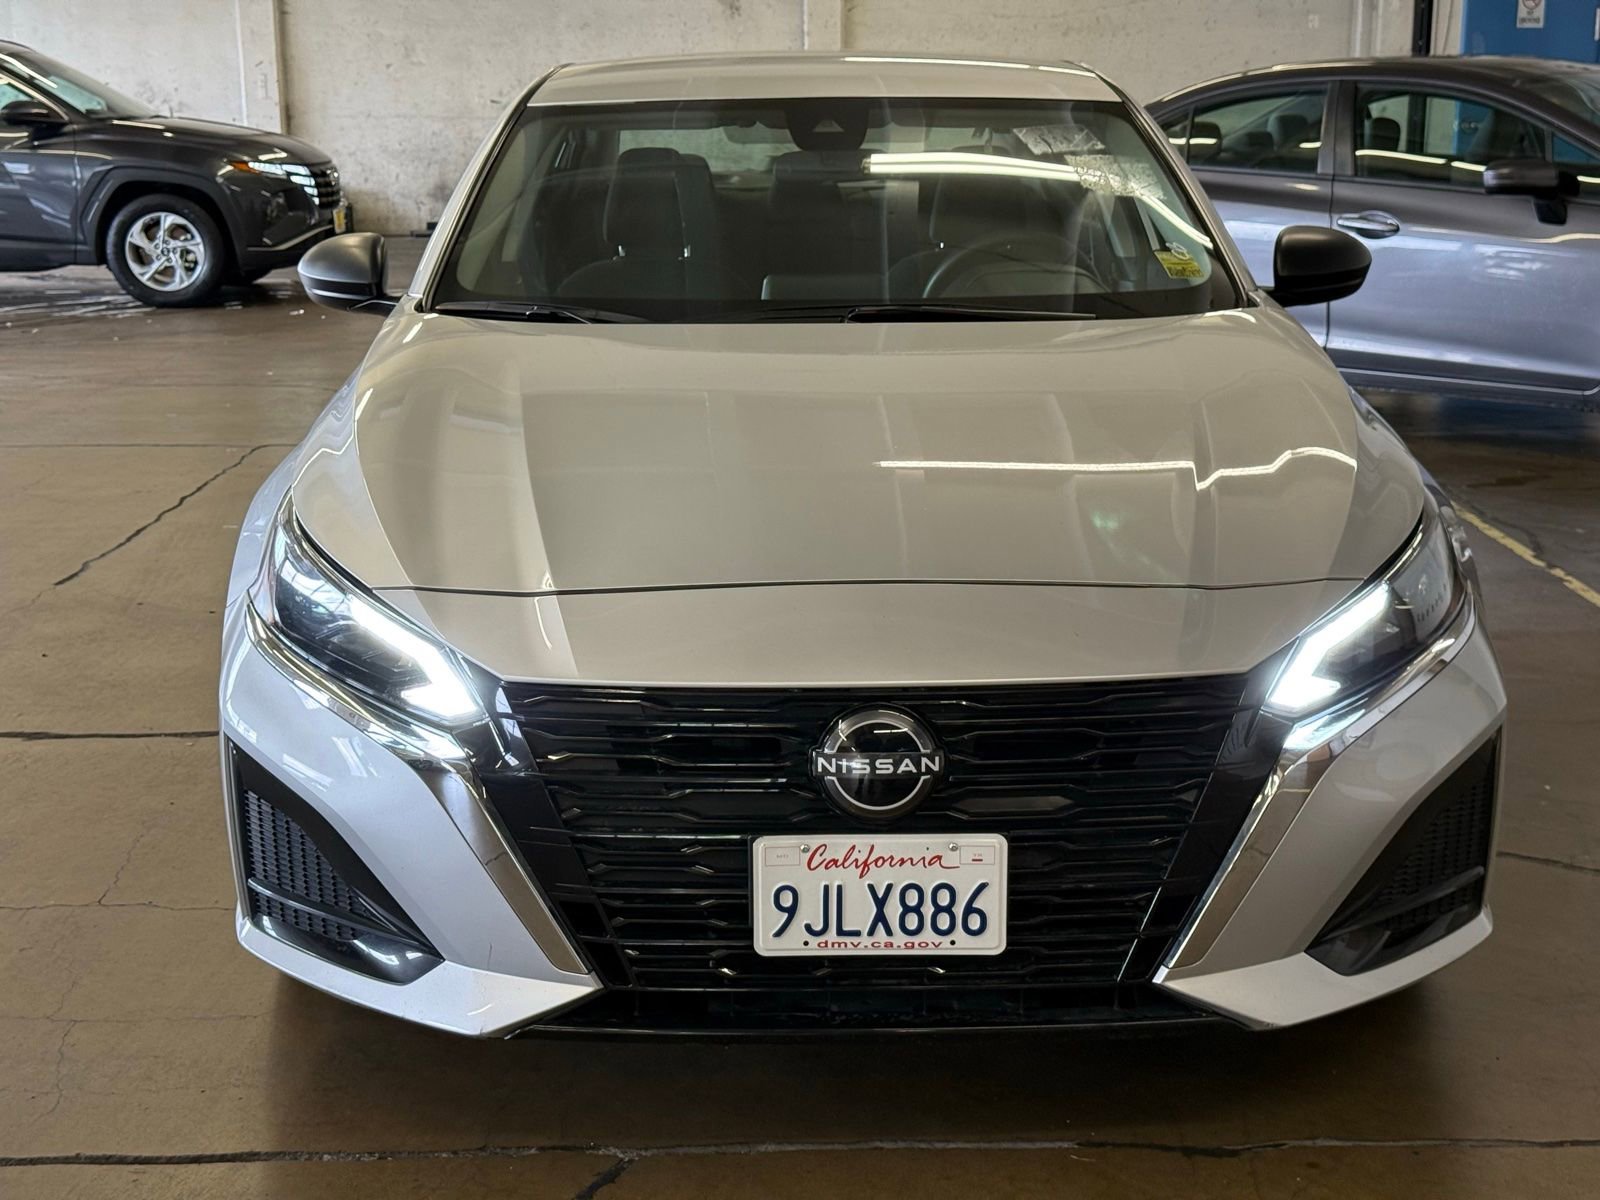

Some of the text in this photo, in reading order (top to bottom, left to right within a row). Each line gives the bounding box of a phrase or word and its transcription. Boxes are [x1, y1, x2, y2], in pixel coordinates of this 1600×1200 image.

[817, 756, 940, 774] NISSAN
[806, 843, 960, 879] California
[772, 882, 989, 937] 9JLX886
[817, 940, 942, 949] dmv.ca.gov
